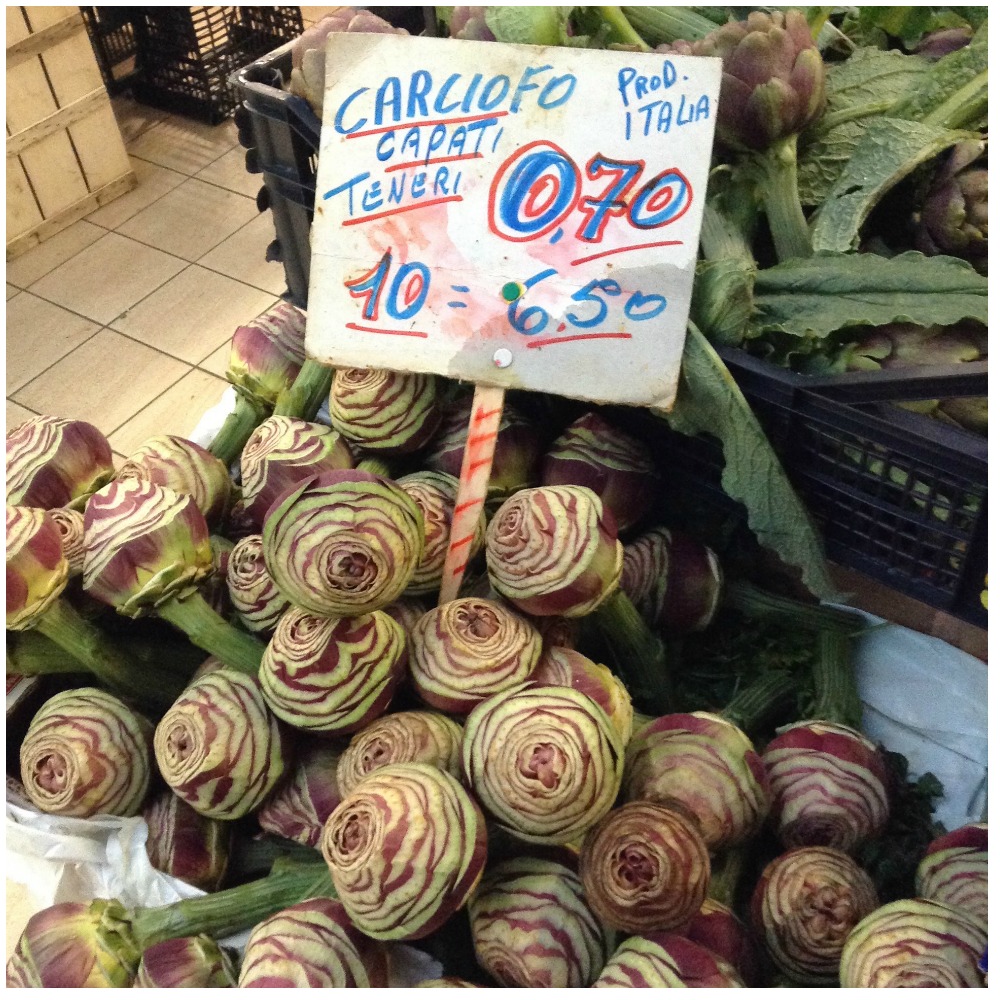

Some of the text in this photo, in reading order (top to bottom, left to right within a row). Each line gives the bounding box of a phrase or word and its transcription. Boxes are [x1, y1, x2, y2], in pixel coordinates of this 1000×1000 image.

[334, 65, 577, 135] CARCIOFO
[626, 94, 709, 141] ITALIA
[376, 118, 504, 166] CAPATI
[324, 170, 462, 216] TENERI
[345, 247, 431, 321] 10
